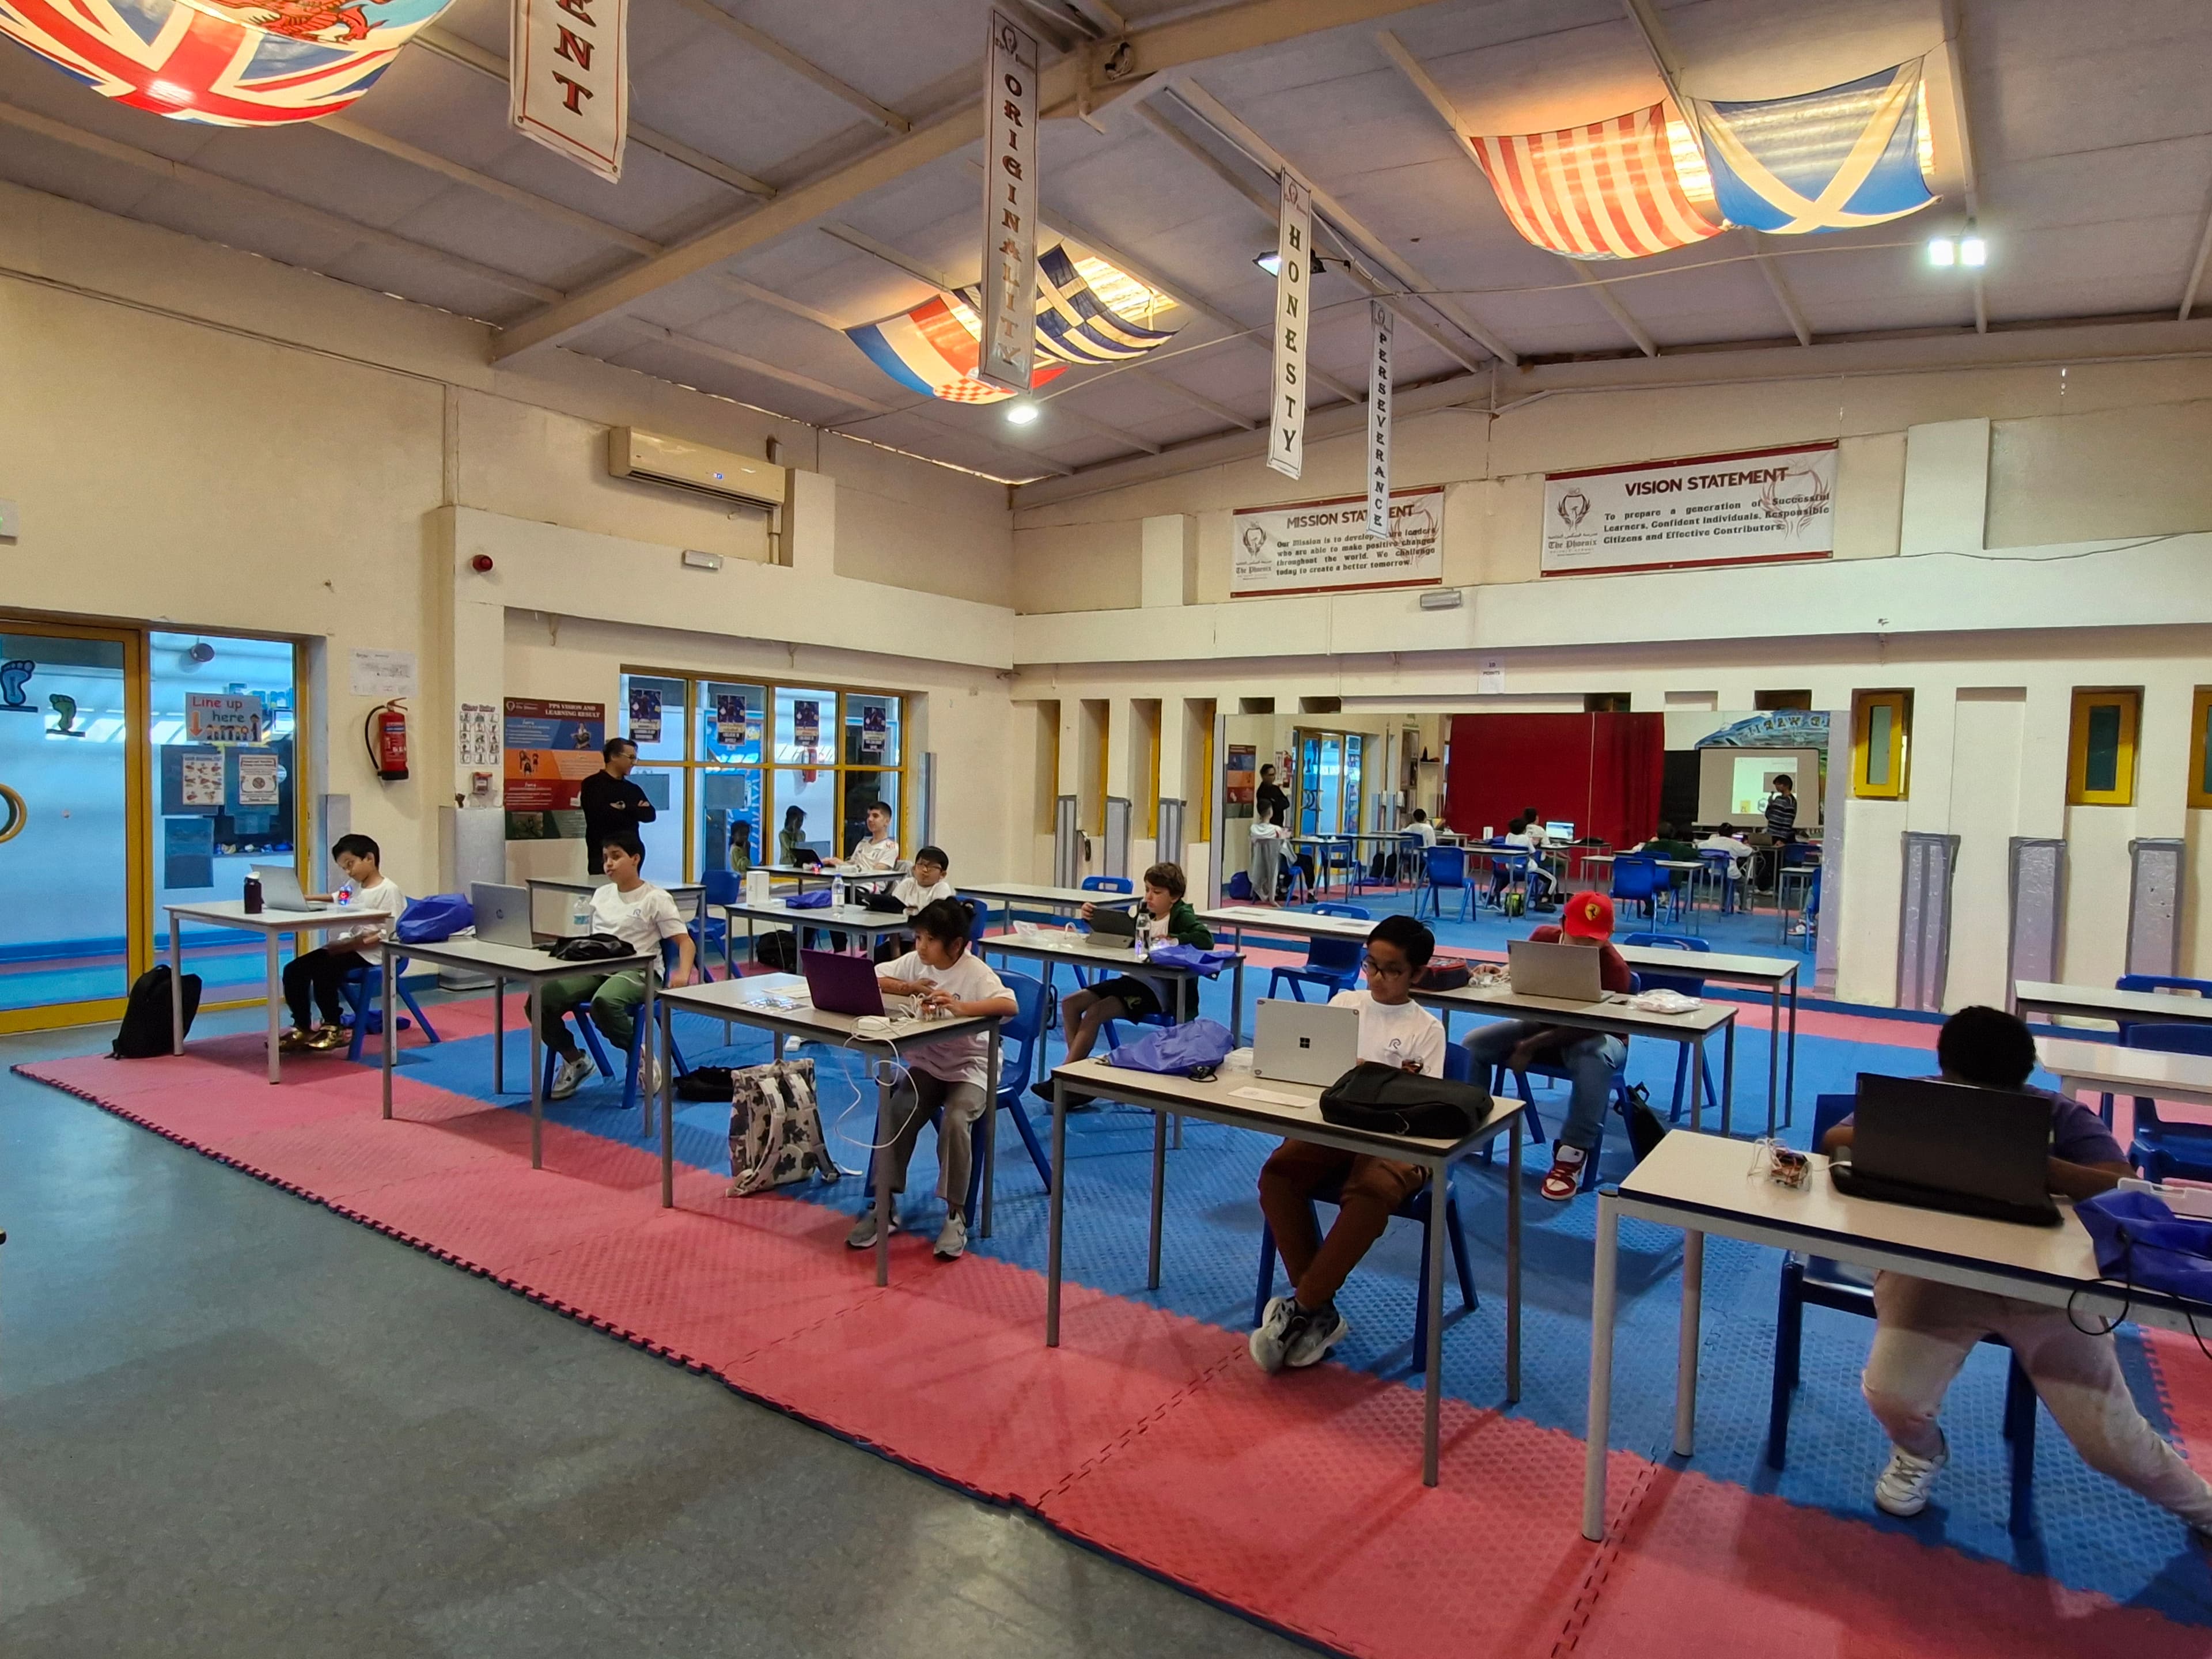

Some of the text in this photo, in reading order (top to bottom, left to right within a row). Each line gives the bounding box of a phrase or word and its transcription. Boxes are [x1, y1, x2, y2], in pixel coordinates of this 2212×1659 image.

[999, 73, 1024, 366] ORIGINALITY
[1282, 223, 1301, 454] HONESTY
[1374, 332, 1387, 527] PERSEVERANCE
[1625, 467, 1789, 497] VISION STATEMENT
[1624, 510, 1661, 520] prepare
[1686, 502, 1741, 514] generation
[1752, 499, 1761, 507] of
[1772, 493, 1830, 506] Successful
[1286, 513, 1338, 529] MISSION
[1651, 517, 1700, 528] Confident
[1765, 507, 1830, 519] Responsible
[1405, 528, 1435, 536] leaders
[1604, 535, 1642, 544] Citizens
[1646, 532, 1662, 540] and
[1666, 529, 1710, 539] Effective
[1342, 543, 1362, 551] make
[1366, 541, 1398, 551] positive
[1402, 537, 1435, 546] changes
[1548, 541, 1563, 549] The
[1277, 557, 1317, 566] throughout
[1395, 548, 1435, 557] challenge
[192, 696, 243, 711] Line up
[213, 710, 245, 722] here
